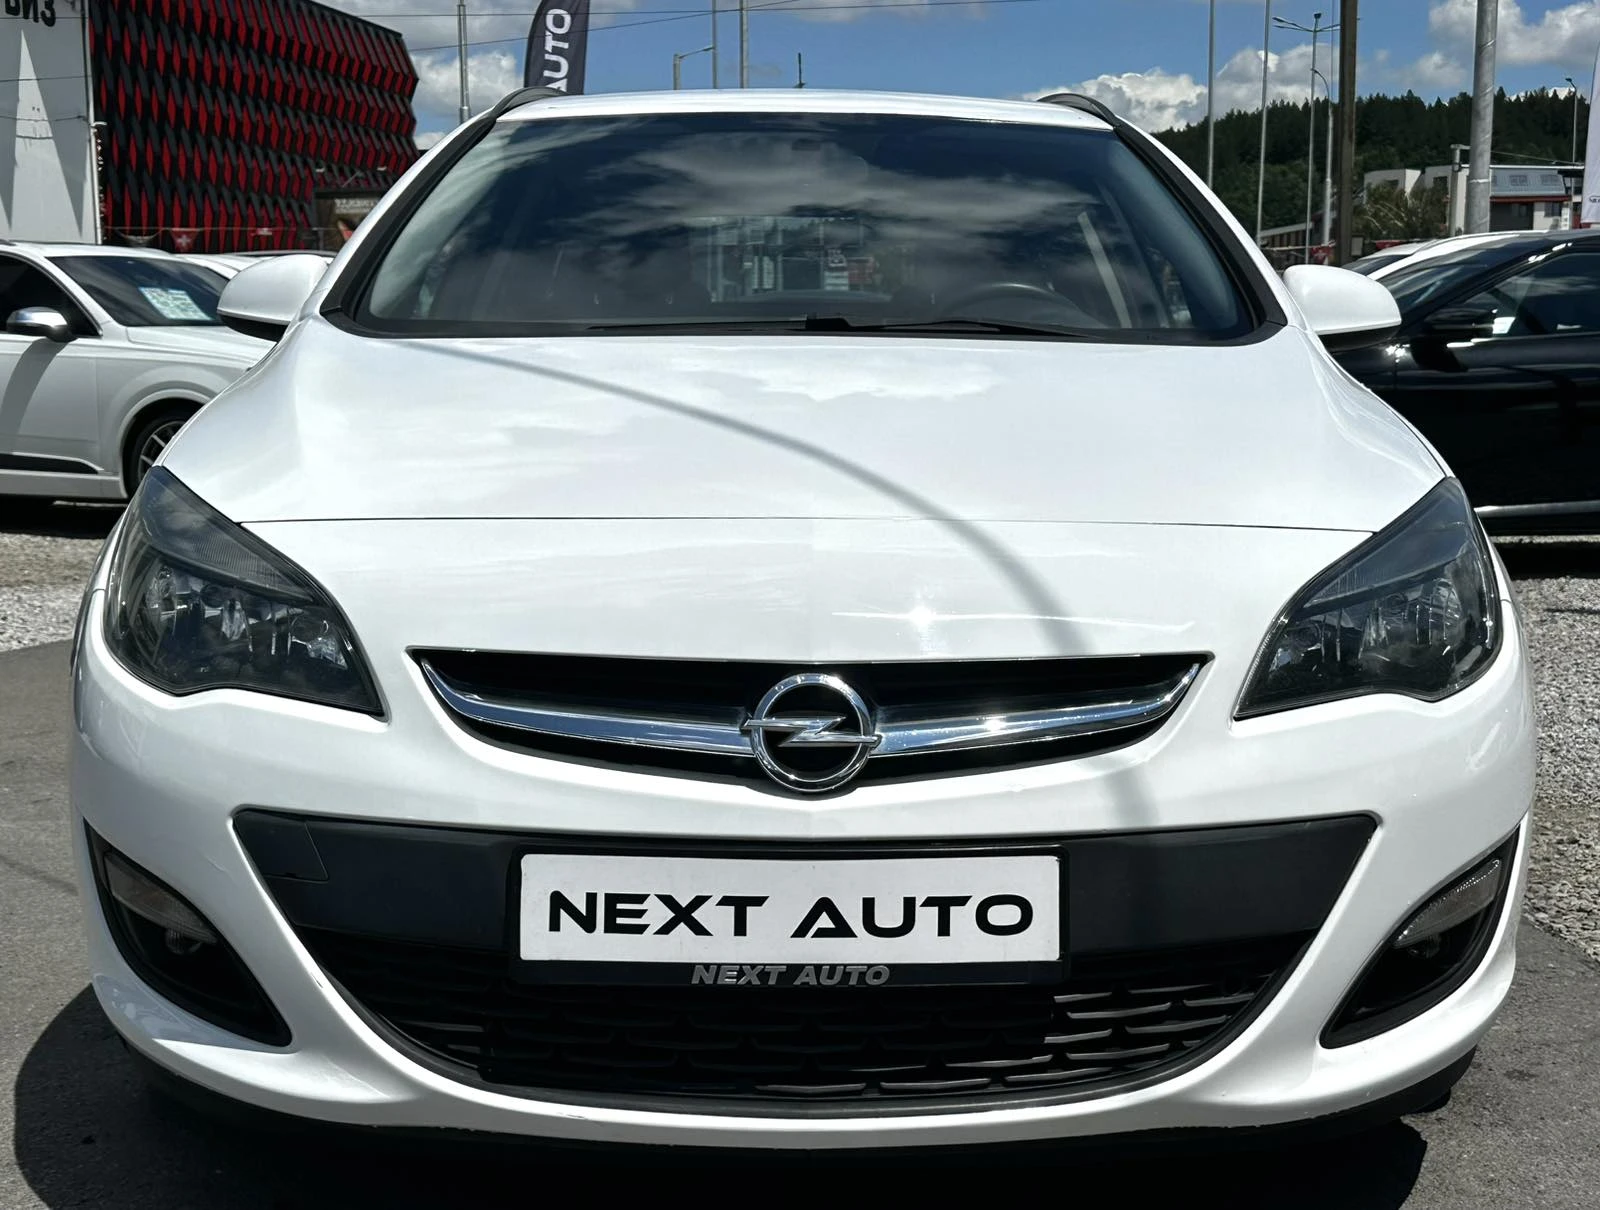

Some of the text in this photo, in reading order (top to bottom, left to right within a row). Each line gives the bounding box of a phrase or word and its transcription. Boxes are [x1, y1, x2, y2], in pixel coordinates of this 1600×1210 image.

[549, 890, 1034, 938] NEXT AUTO
[691, 964, 890, 986] NEXT AUTO
